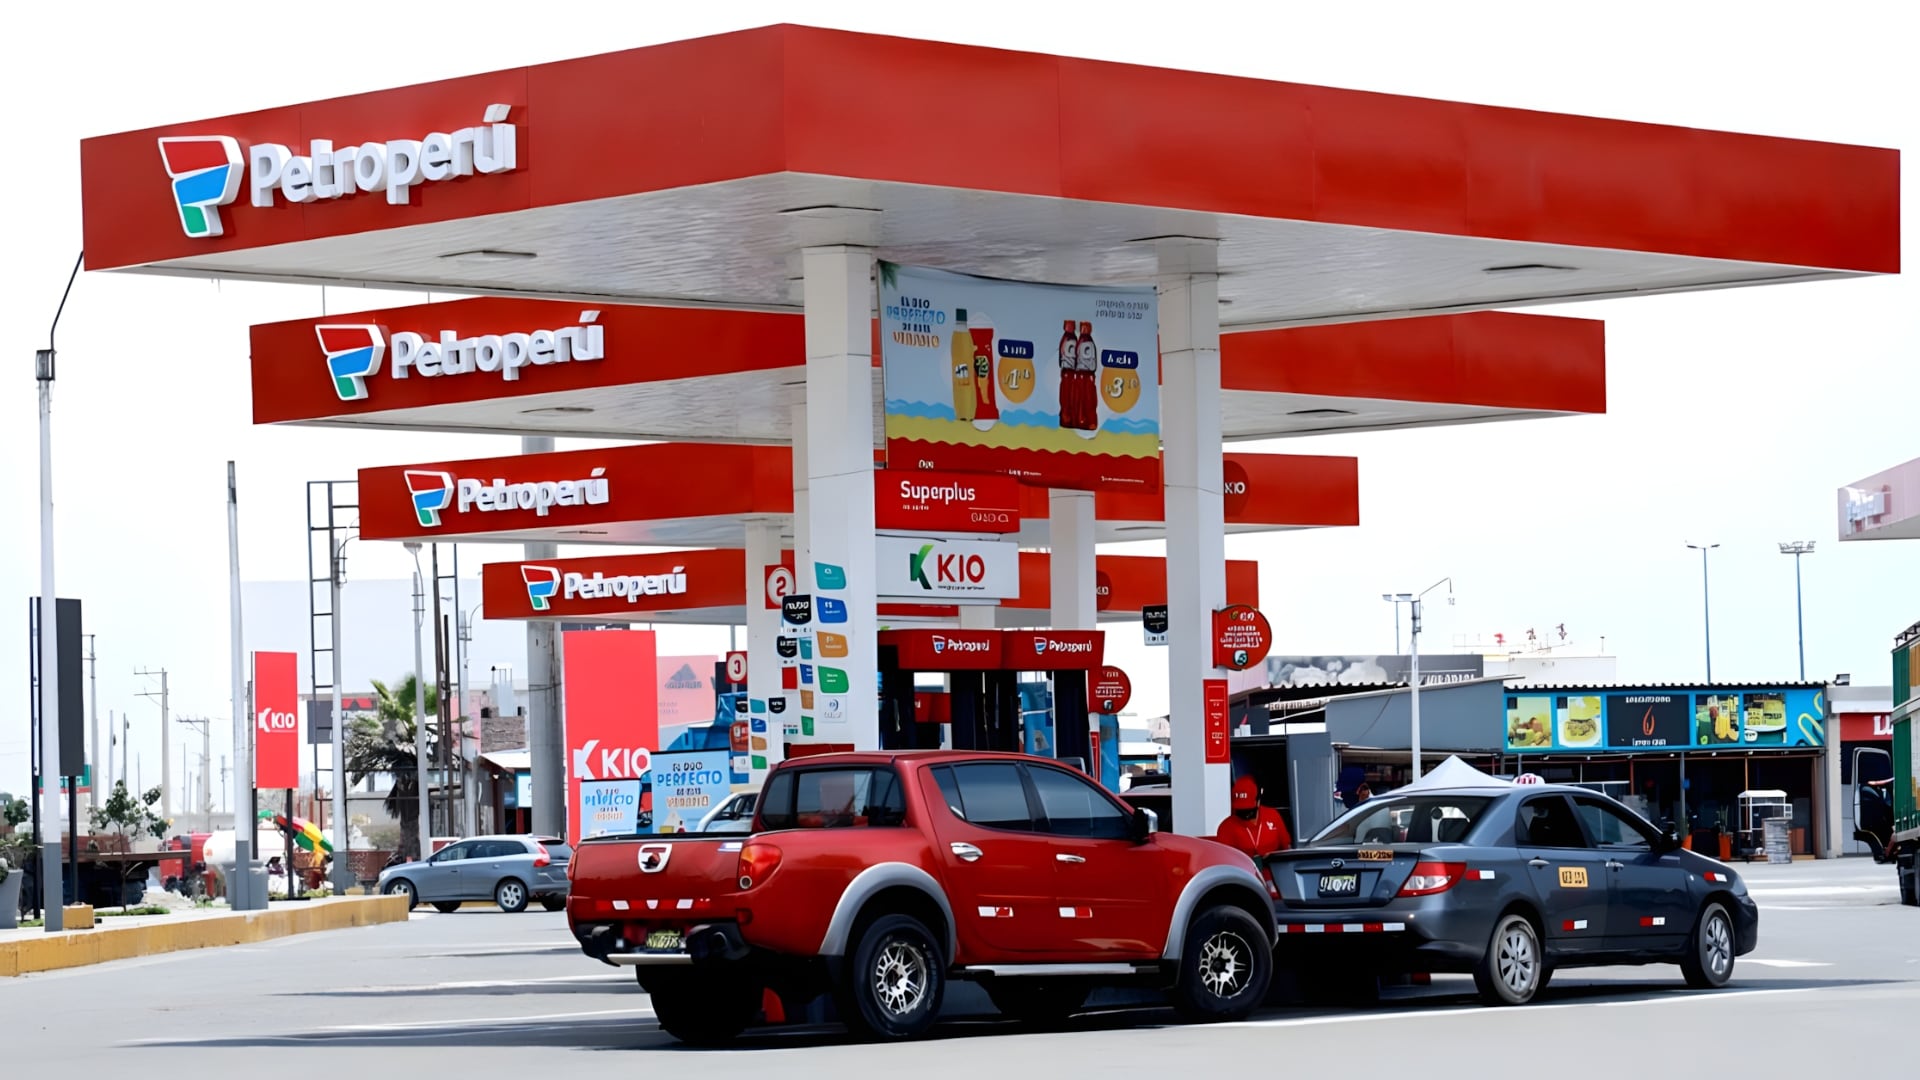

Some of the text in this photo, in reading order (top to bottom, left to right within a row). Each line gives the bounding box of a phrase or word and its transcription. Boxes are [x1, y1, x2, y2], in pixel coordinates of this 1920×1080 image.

[250, 103, 517, 208] Petroperú
[391, 309, 605, 381] Petroperú
[457, 467, 609, 517] Petroperú
[900, 480, 976, 505] Superplus
[563, 565, 687, 603] Petroperú
[937, 553, 985, 583] KIO
[776, 576, 786, 596] 2
[601, 747, 652, 779] KIO
[657, 770, 723, 787] PERFECTO
